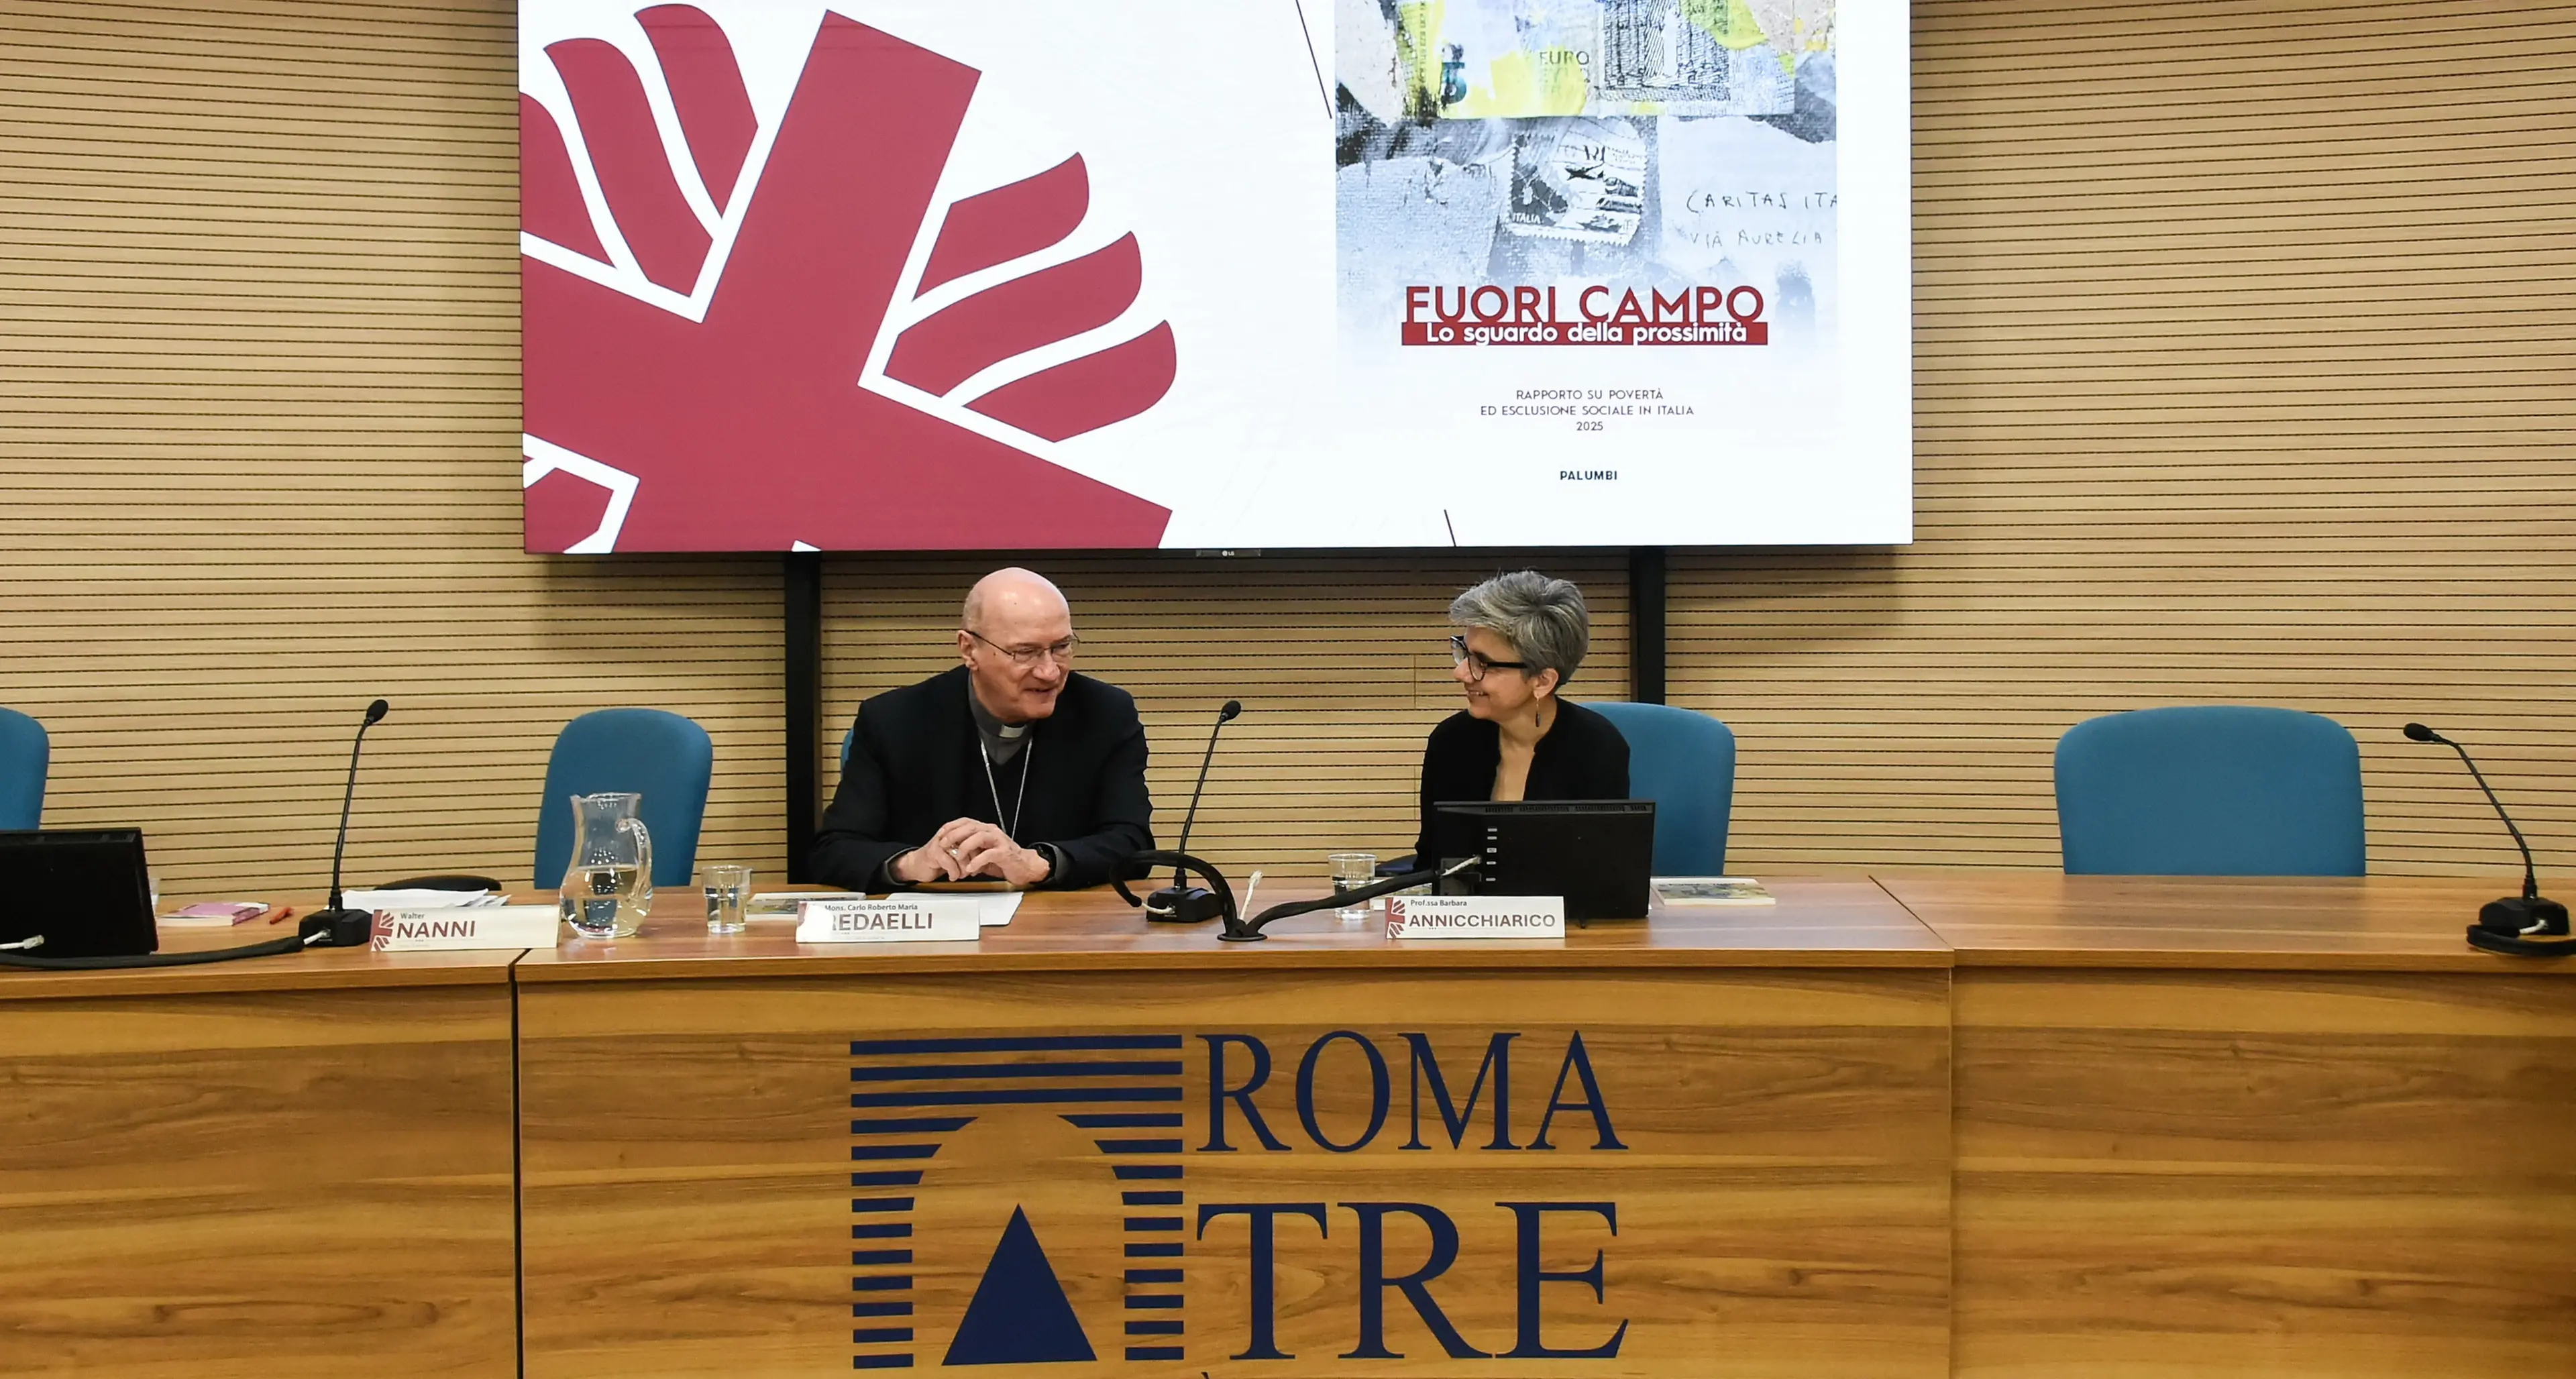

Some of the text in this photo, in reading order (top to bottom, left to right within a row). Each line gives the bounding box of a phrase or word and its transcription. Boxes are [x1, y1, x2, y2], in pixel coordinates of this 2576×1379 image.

[1540, 50, 1589, 65] EURO
[1686, 188, 1786, 214] CARITAS
[1512, 212, 1541, 224] ITALIA
[1406, 284, 1764, 323] FUORI CAMPO
[1427, 322, 1747, 346] Lo sguardo della prossimità
[1516, 388, 1664, 400] RAPPORTO SU POVERTÀ
[1481, 405, 1694, 416] ED ESCLUSIONE SOCIALE IN ITALIA
[1576, 421, 1604, 431] 2025
[1560, 470, 1617, 480] PALUMBI
[1409, 914, 1555, 928] ANNICCHIARICO
[396, 920, 476, 938] NANNI
[1196, 1030, 1629, 1153] ROMA
[1196, 1201, 1629, 1360] TRE
